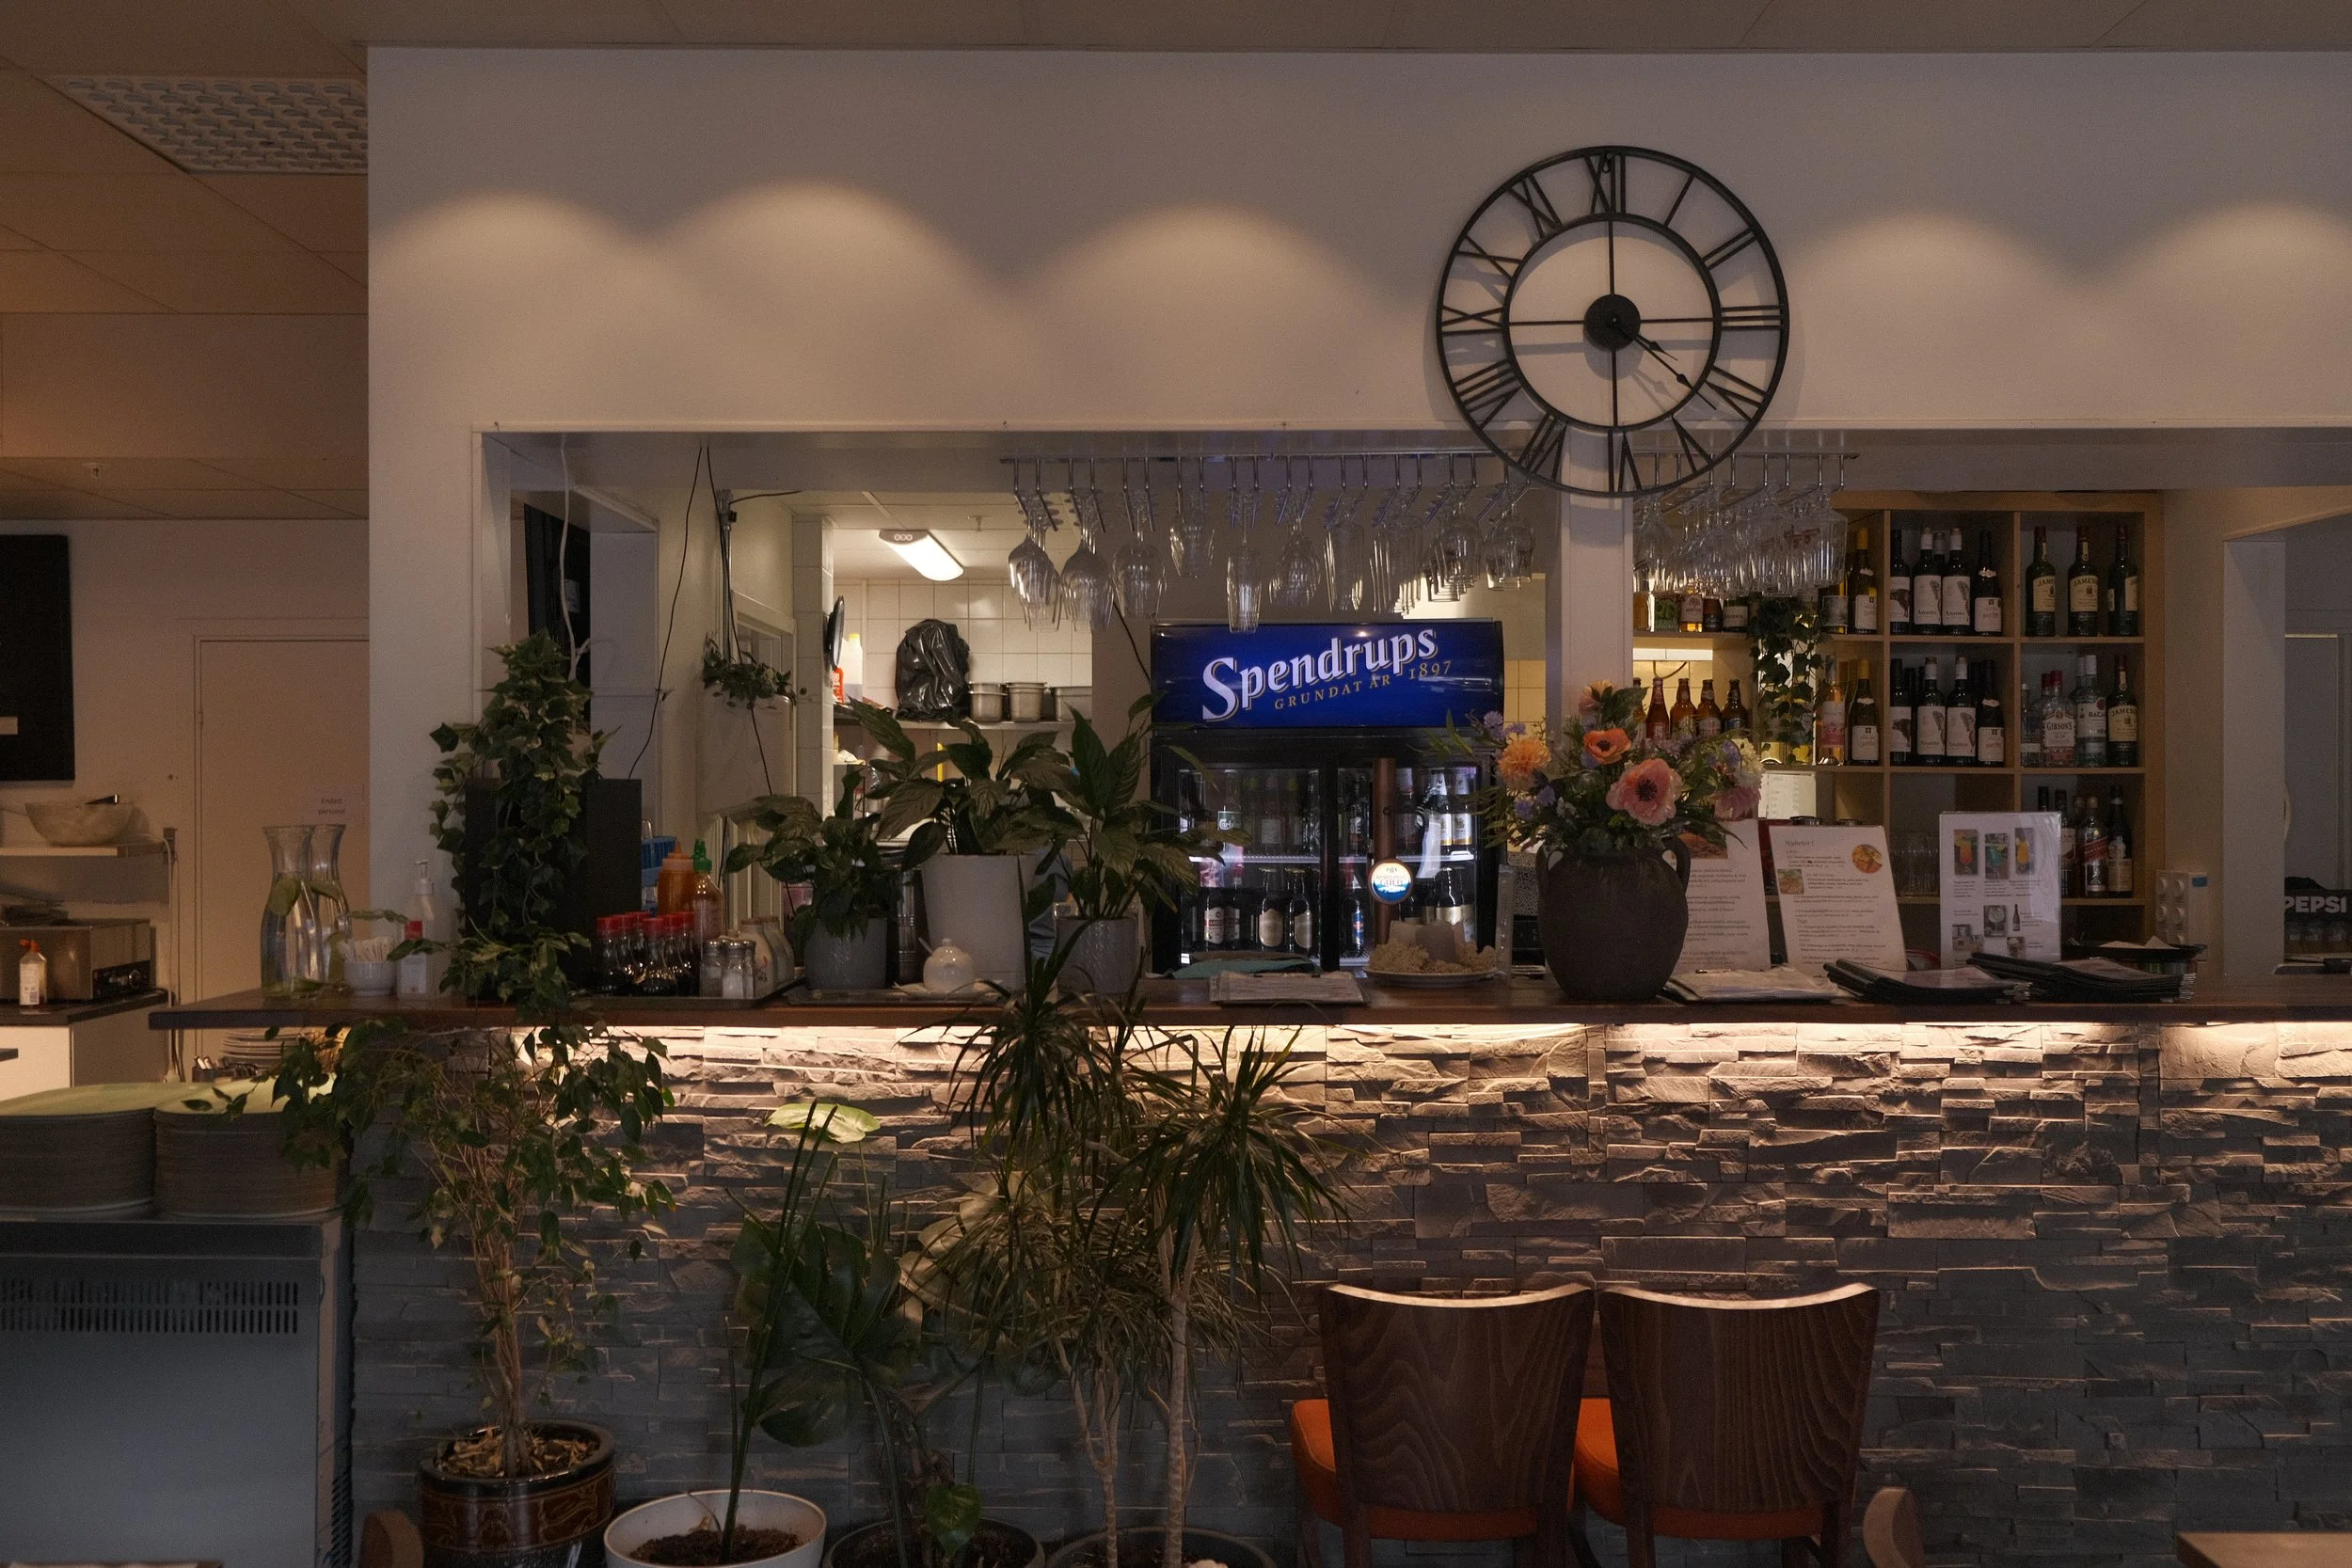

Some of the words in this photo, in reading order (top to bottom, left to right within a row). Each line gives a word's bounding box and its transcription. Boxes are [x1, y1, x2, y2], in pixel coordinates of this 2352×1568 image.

[1202, 628, 1438, 721] Spendrups
[1274, 680, 1362, 710] GRUNDAT
[1408, 660, 1452, 680] 1897
[2283, 895, 2347, 914] PEPSI
